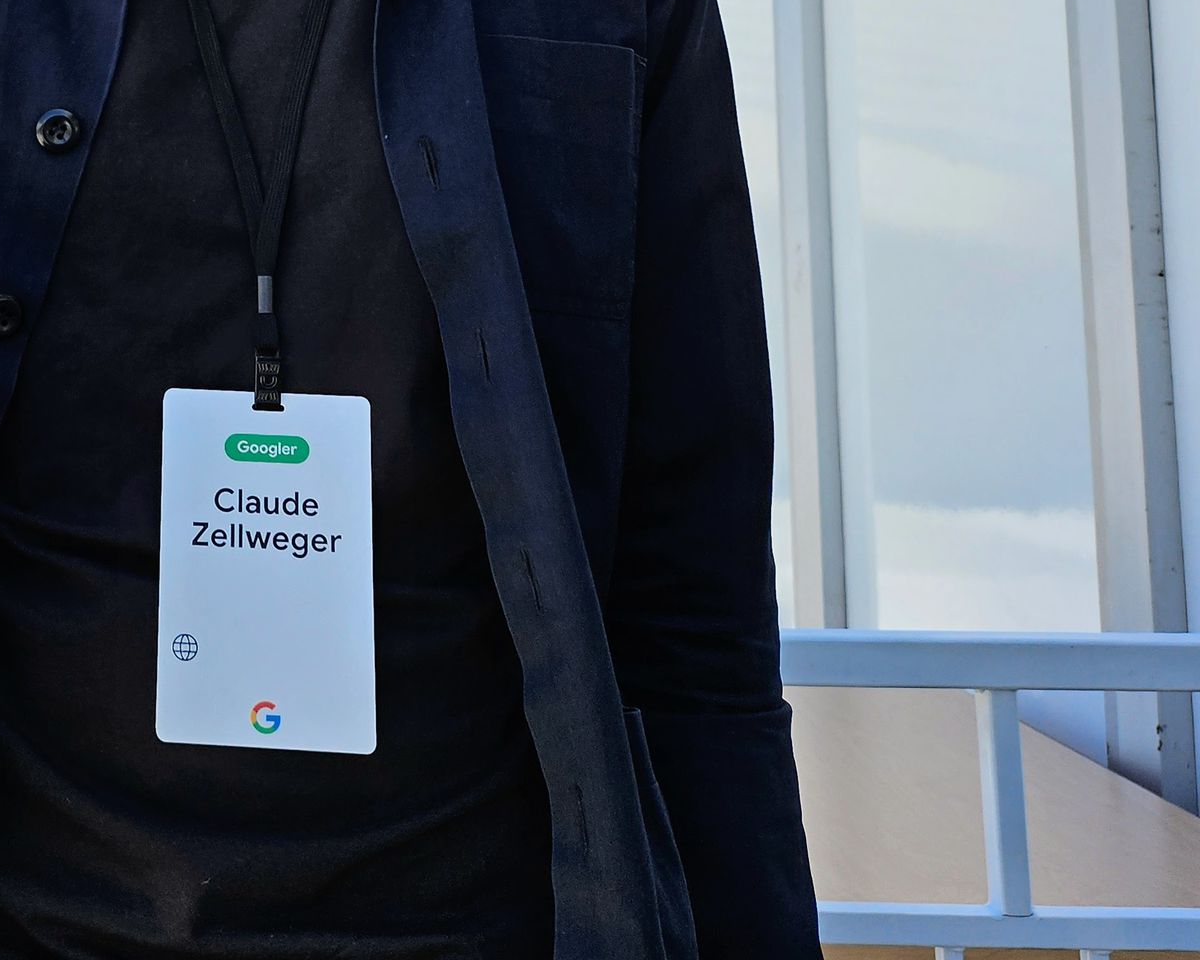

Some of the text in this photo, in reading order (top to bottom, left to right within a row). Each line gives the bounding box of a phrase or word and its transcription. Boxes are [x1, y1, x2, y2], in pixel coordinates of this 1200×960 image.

[237, 440, 297, 457] Googler
[214, 488, 319, 516] Claude
[192, 522, 342, 558] Zellweger
[251, 701, 281, 734] G
